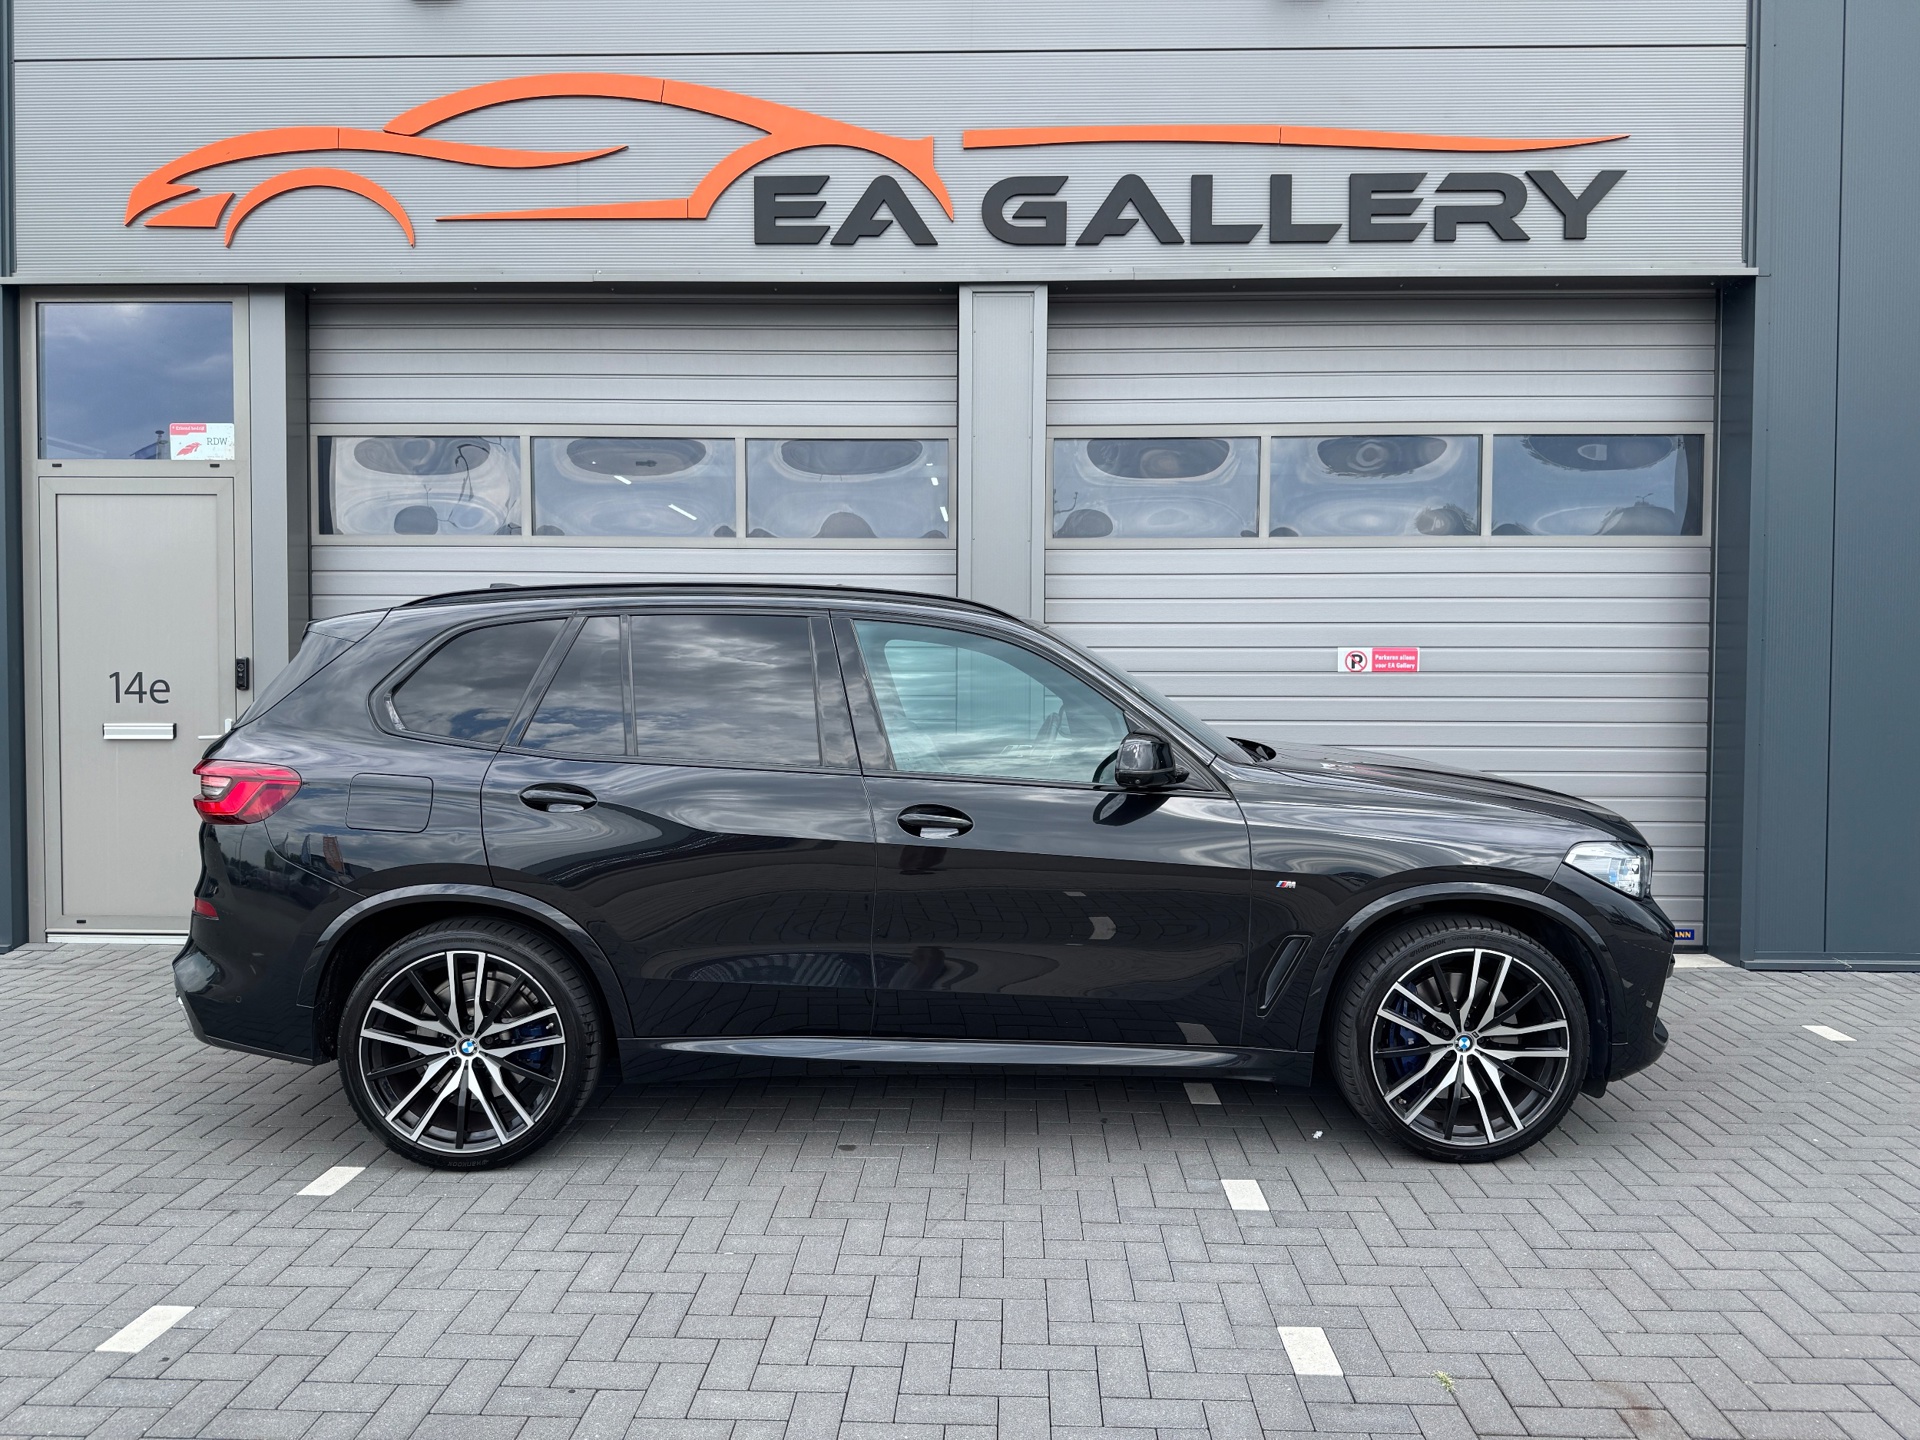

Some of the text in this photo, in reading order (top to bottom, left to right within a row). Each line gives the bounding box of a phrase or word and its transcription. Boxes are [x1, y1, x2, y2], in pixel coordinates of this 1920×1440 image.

[754, 169, 1628, 246] EA GALLERY
[206, 437, 228, 446] RDW
[1396, 662, 1416, 670] Gallery
[109, 671, 171, 704] 14e
